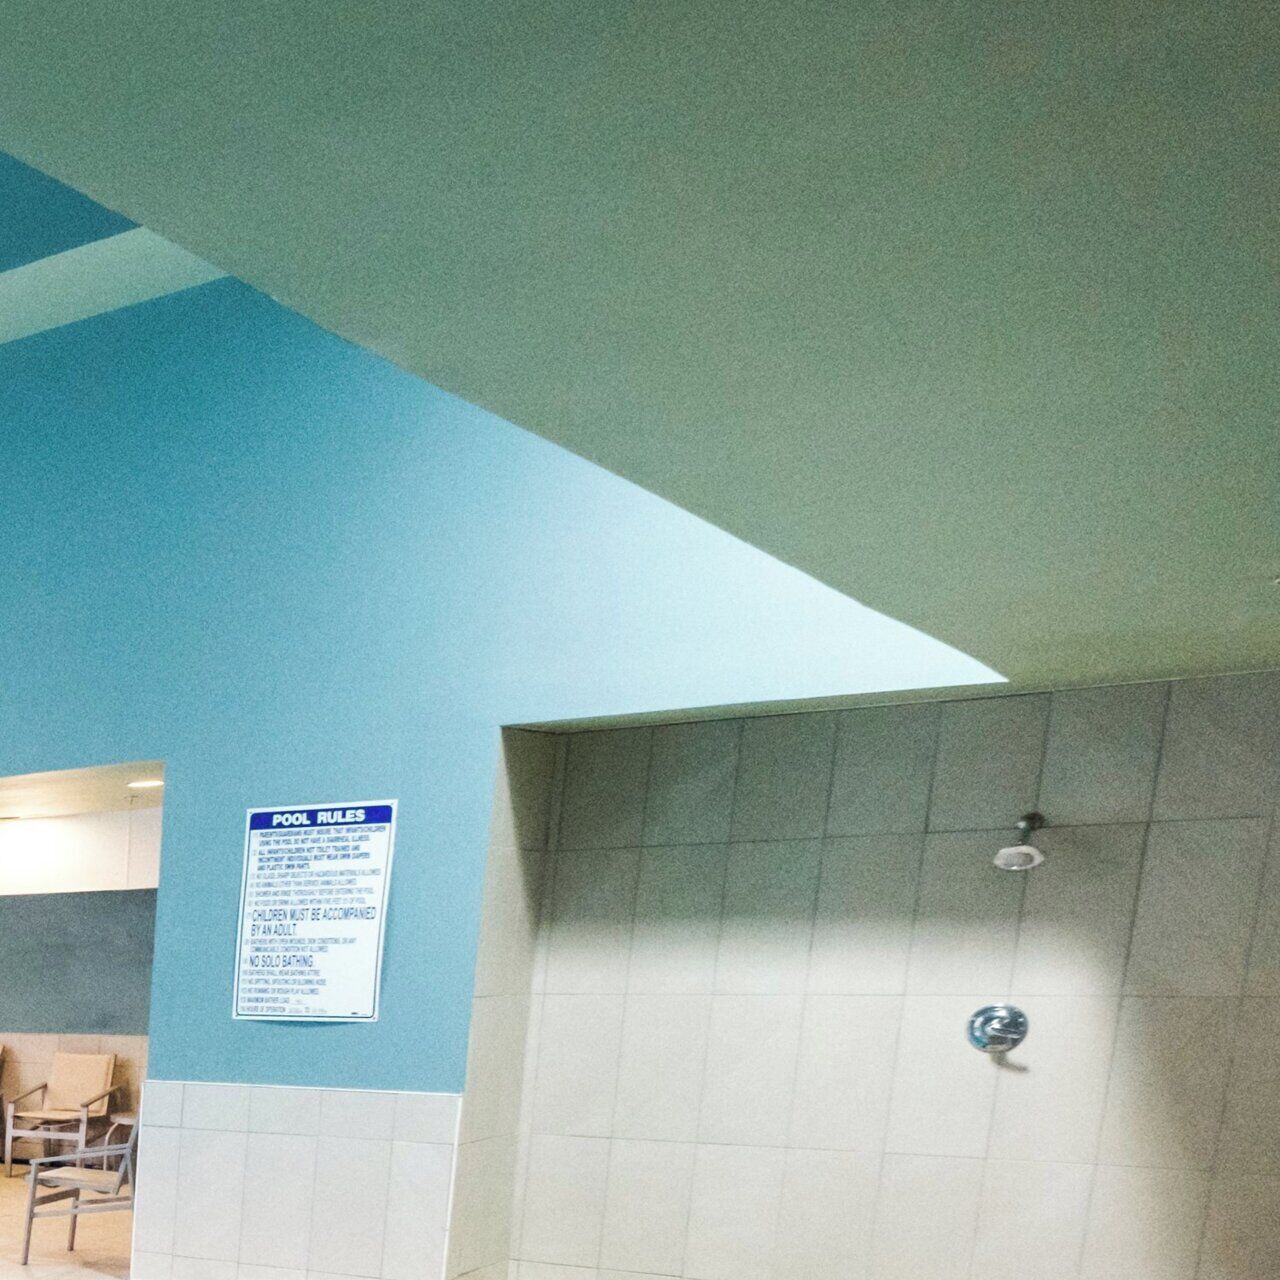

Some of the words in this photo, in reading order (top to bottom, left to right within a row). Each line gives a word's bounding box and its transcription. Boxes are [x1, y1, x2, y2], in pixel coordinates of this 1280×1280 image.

[272, 813, 310, 826] POOL
[317, 809, 366, 824] RULES
[252, 908, 287, 922] CHILDREN
[289, 908, 310, 921] MUST
[311, 908, 322, 920] BE
[322, 906, 377, 920] ACCOMPANIED
[251, 924, 260, 936] BY
[262, 924, 272, 936] AN
[250, 955, 260, 968] NO
[261, 955, 281, 968] SOLO
